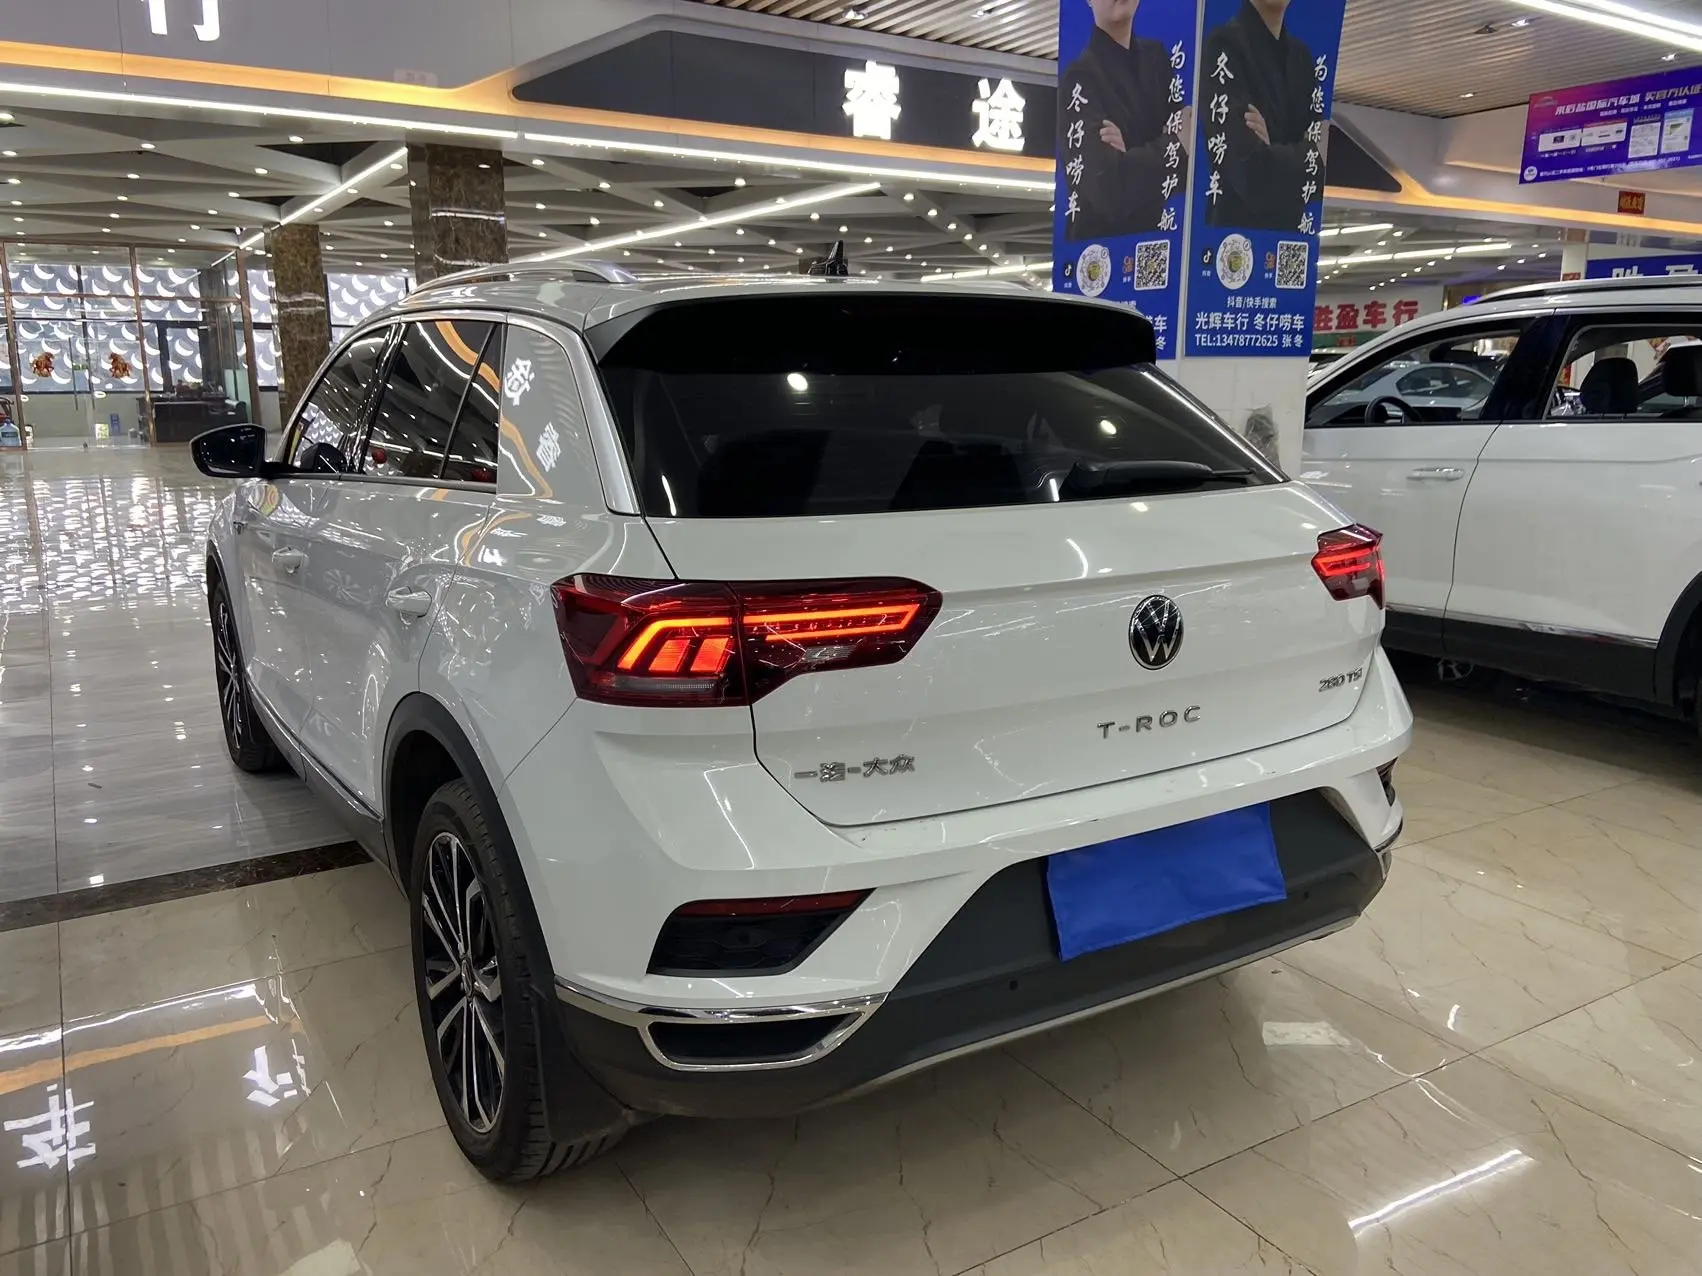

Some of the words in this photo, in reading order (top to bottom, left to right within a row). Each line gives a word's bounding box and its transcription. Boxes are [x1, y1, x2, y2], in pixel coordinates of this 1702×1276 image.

[1065, 82, 1088, 222] 冬仔唠车
[1157, 40, 1187, 231] 为您保驾护航
[1205, 52, 1234, 205] 冬仔唠车
[1297, 54, 1328, 235] 为您保驾护航
[1195, 311, 1249, 331] 光辉车行
[1253, 312, 1305, 331] 冬仔唠车
[1195, 333, 1278, 347] TEL:13478772625
[1097, 705, 1201, 739] T-ROC
